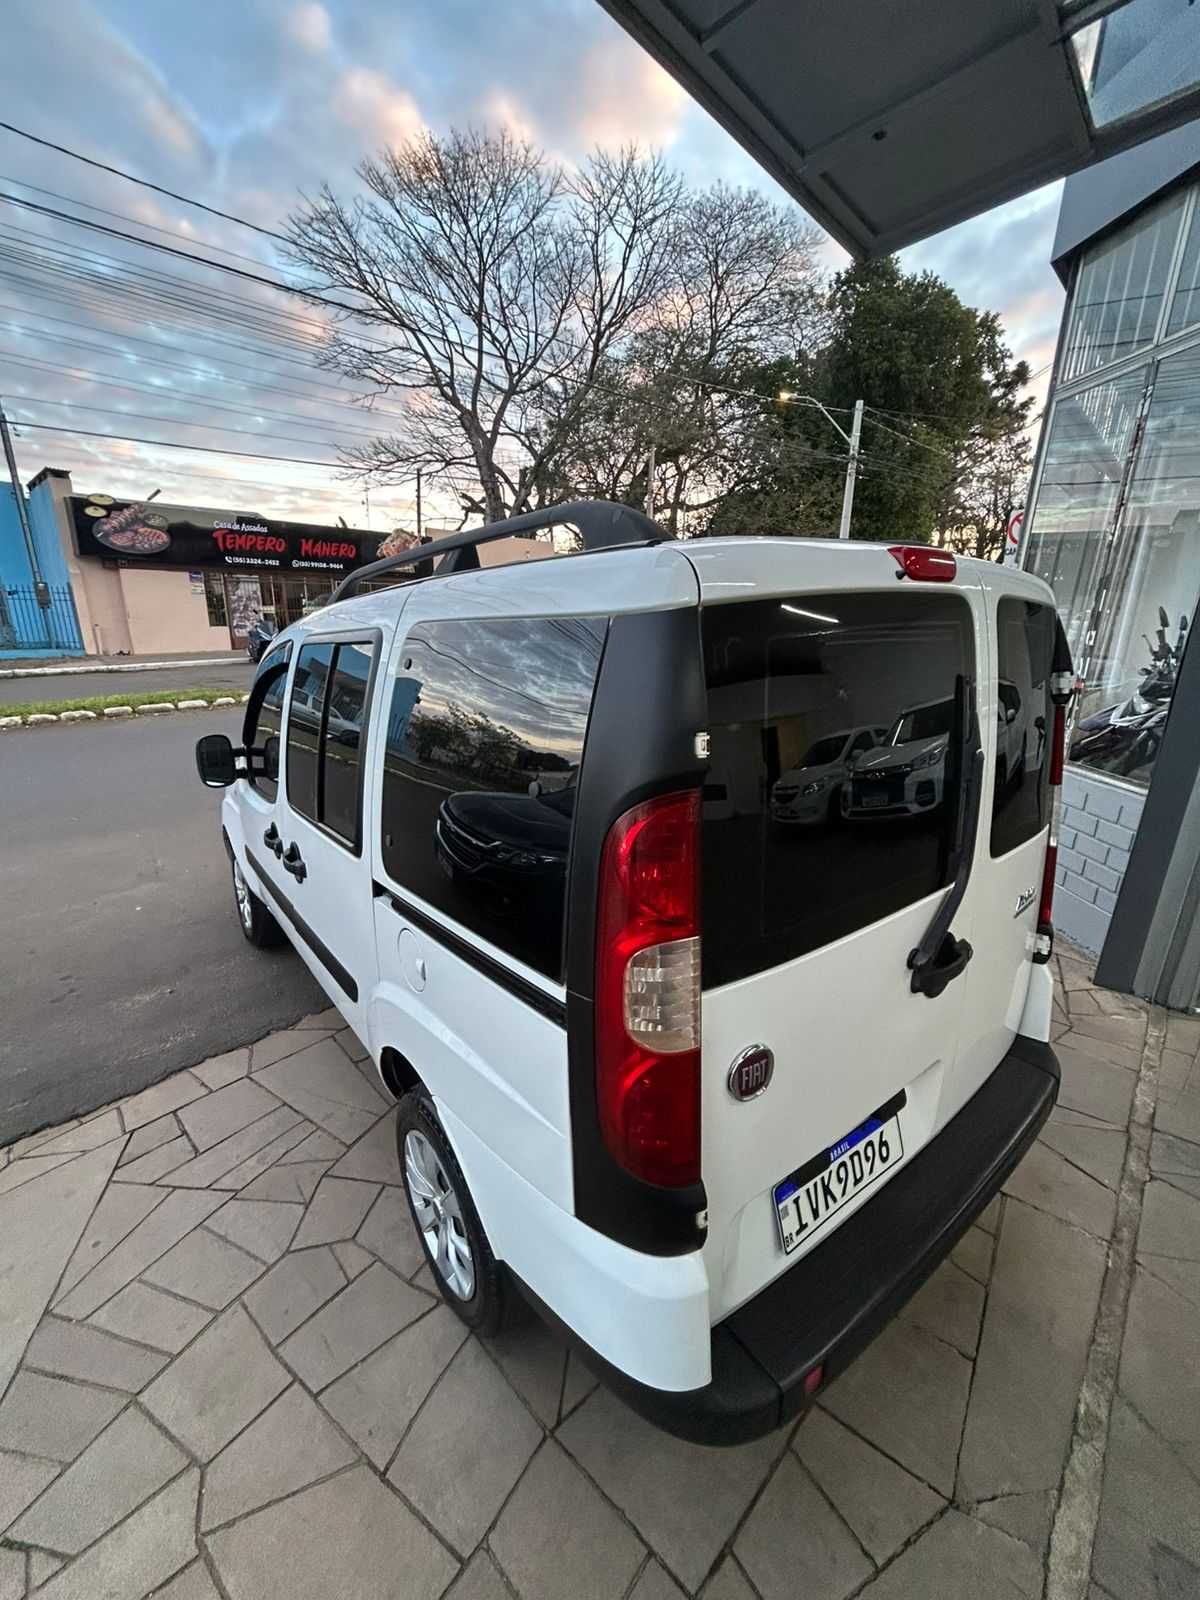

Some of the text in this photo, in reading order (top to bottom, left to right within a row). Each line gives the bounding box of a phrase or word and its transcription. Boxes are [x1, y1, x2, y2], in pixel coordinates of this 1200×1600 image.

[212, 528, 357, 559] TEMPERO MANERO
[742, 1059, 768, 1090] FIAT
[792, 1130, 891, 1237] IVK9D96
